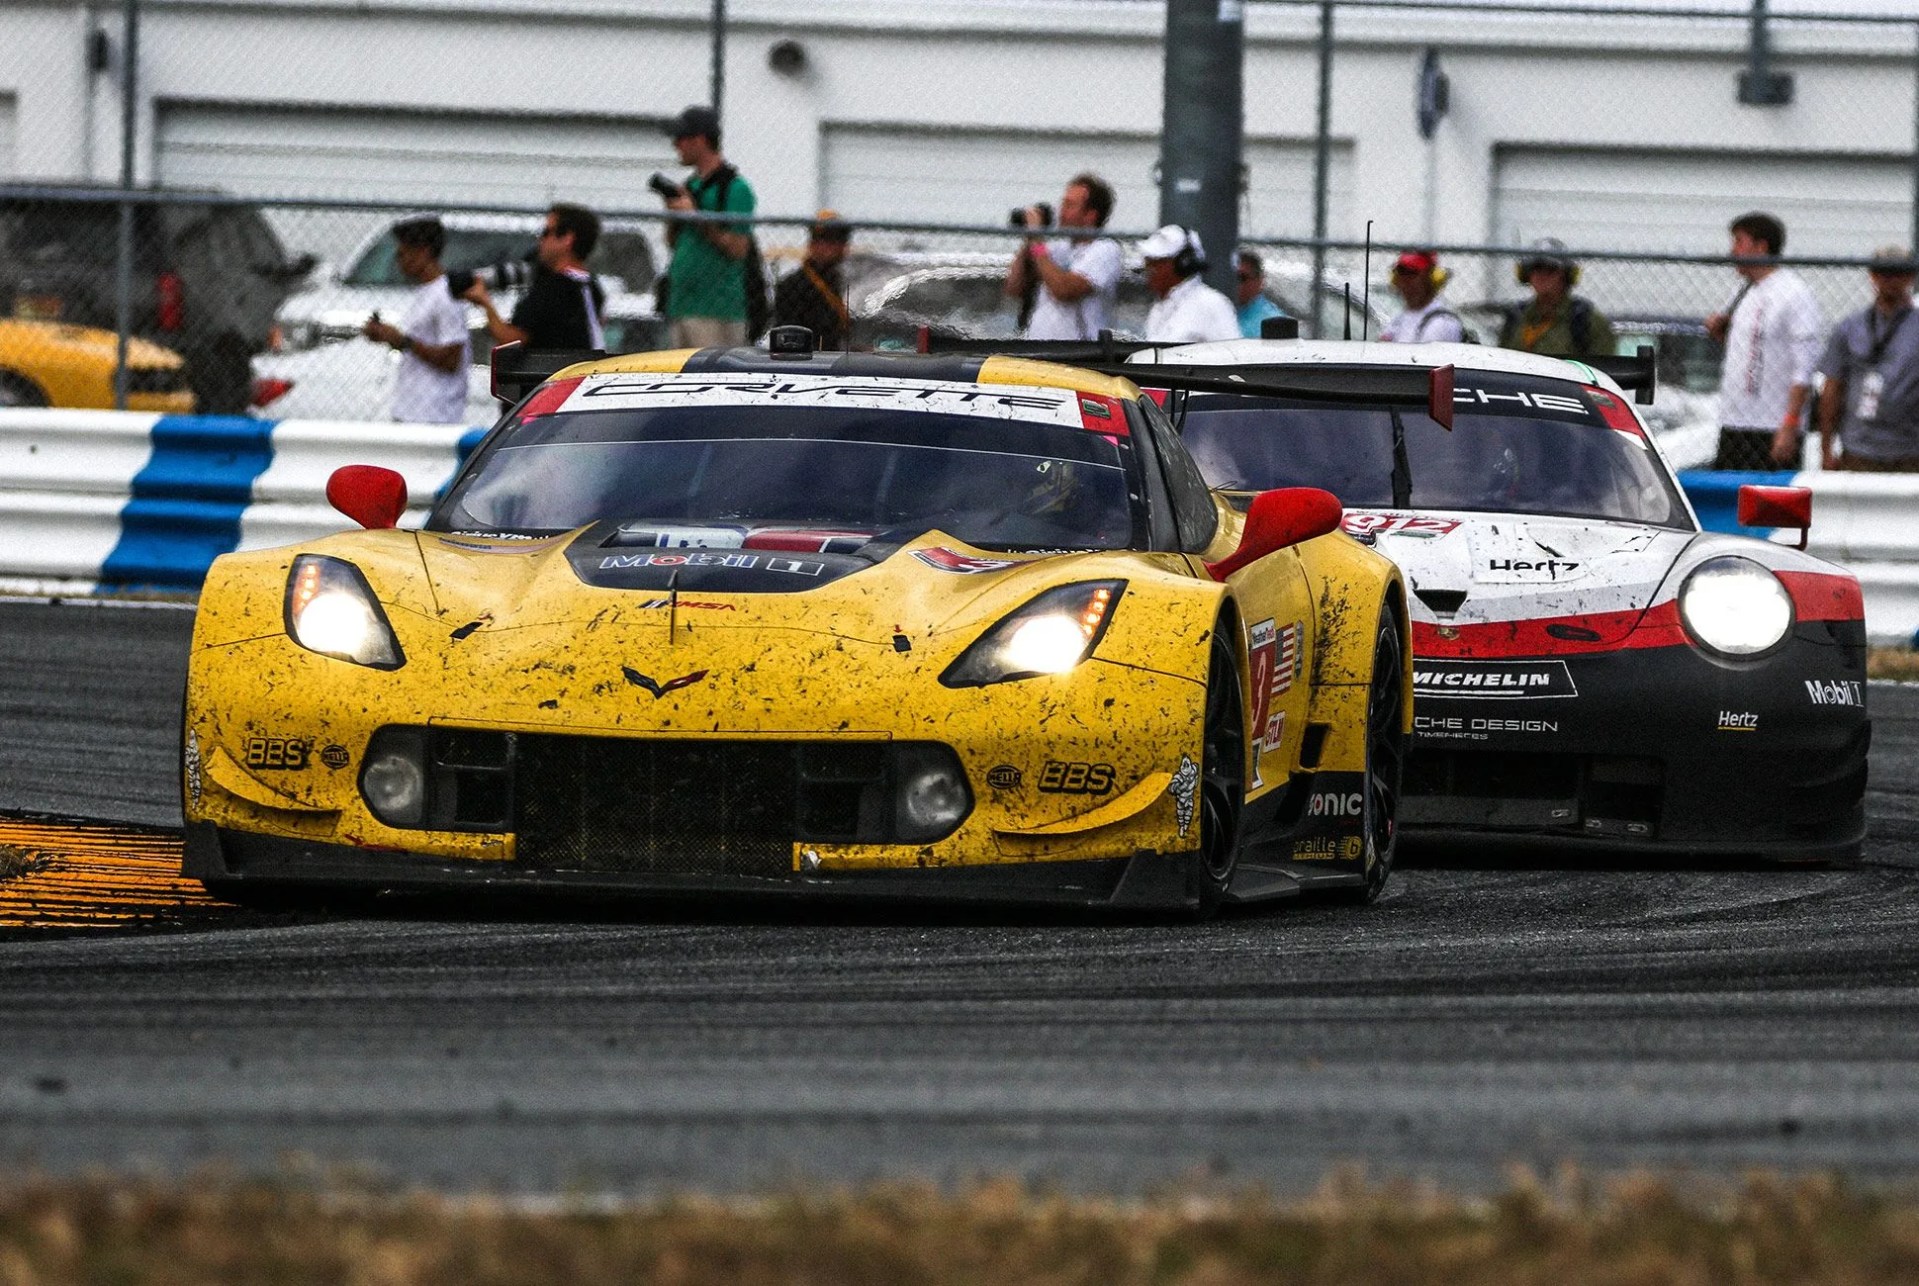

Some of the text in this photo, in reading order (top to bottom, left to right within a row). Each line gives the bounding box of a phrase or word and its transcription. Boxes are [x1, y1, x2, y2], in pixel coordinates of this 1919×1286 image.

[582, 383, 1064, 410] CORVETTE
[1344, 514, 1454, 535] 912
[597, 552, 759, 570] Mobil
[1489, 558, 1579, 572] Hertz
[1412, 671, 1551, 687] MICHELIN
[1804, 679, 1854, 706] Mobil
[1471, 718, 1559, 733] DESIGN
[1718, 710, 1759, 727] Hertz
[247, 737, 306, 771] BBS
[1039, 761, 1116, 795] BBS
